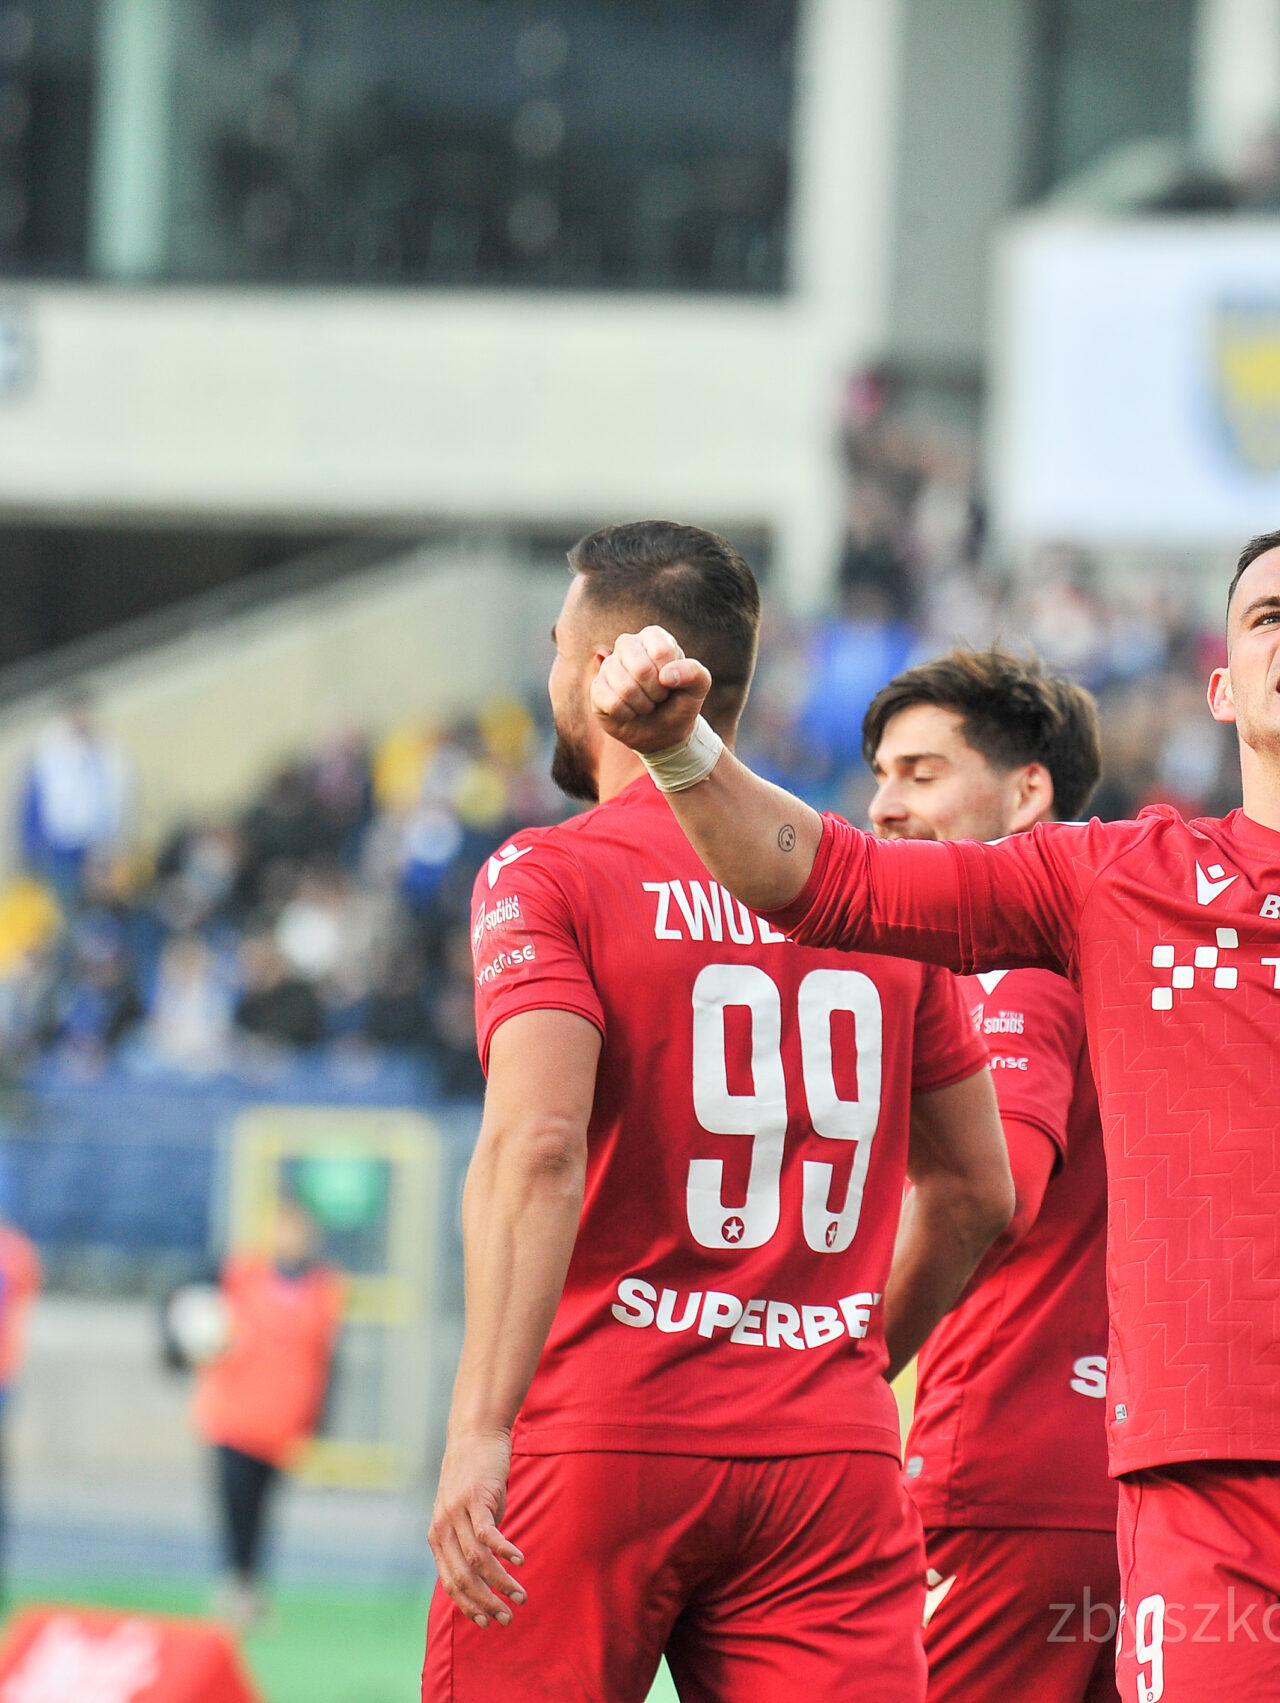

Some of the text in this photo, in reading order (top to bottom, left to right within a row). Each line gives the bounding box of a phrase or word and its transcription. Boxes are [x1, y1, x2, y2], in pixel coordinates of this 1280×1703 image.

[485, 902, 520, 930] SOCIOS
[983, 1017, 1025, 1034] SOCIOS
[686, 963, 883, 1253] 99
[1070, 1355, 1107, 1399] S
[1135, 1593, 1165, 1703] 9
